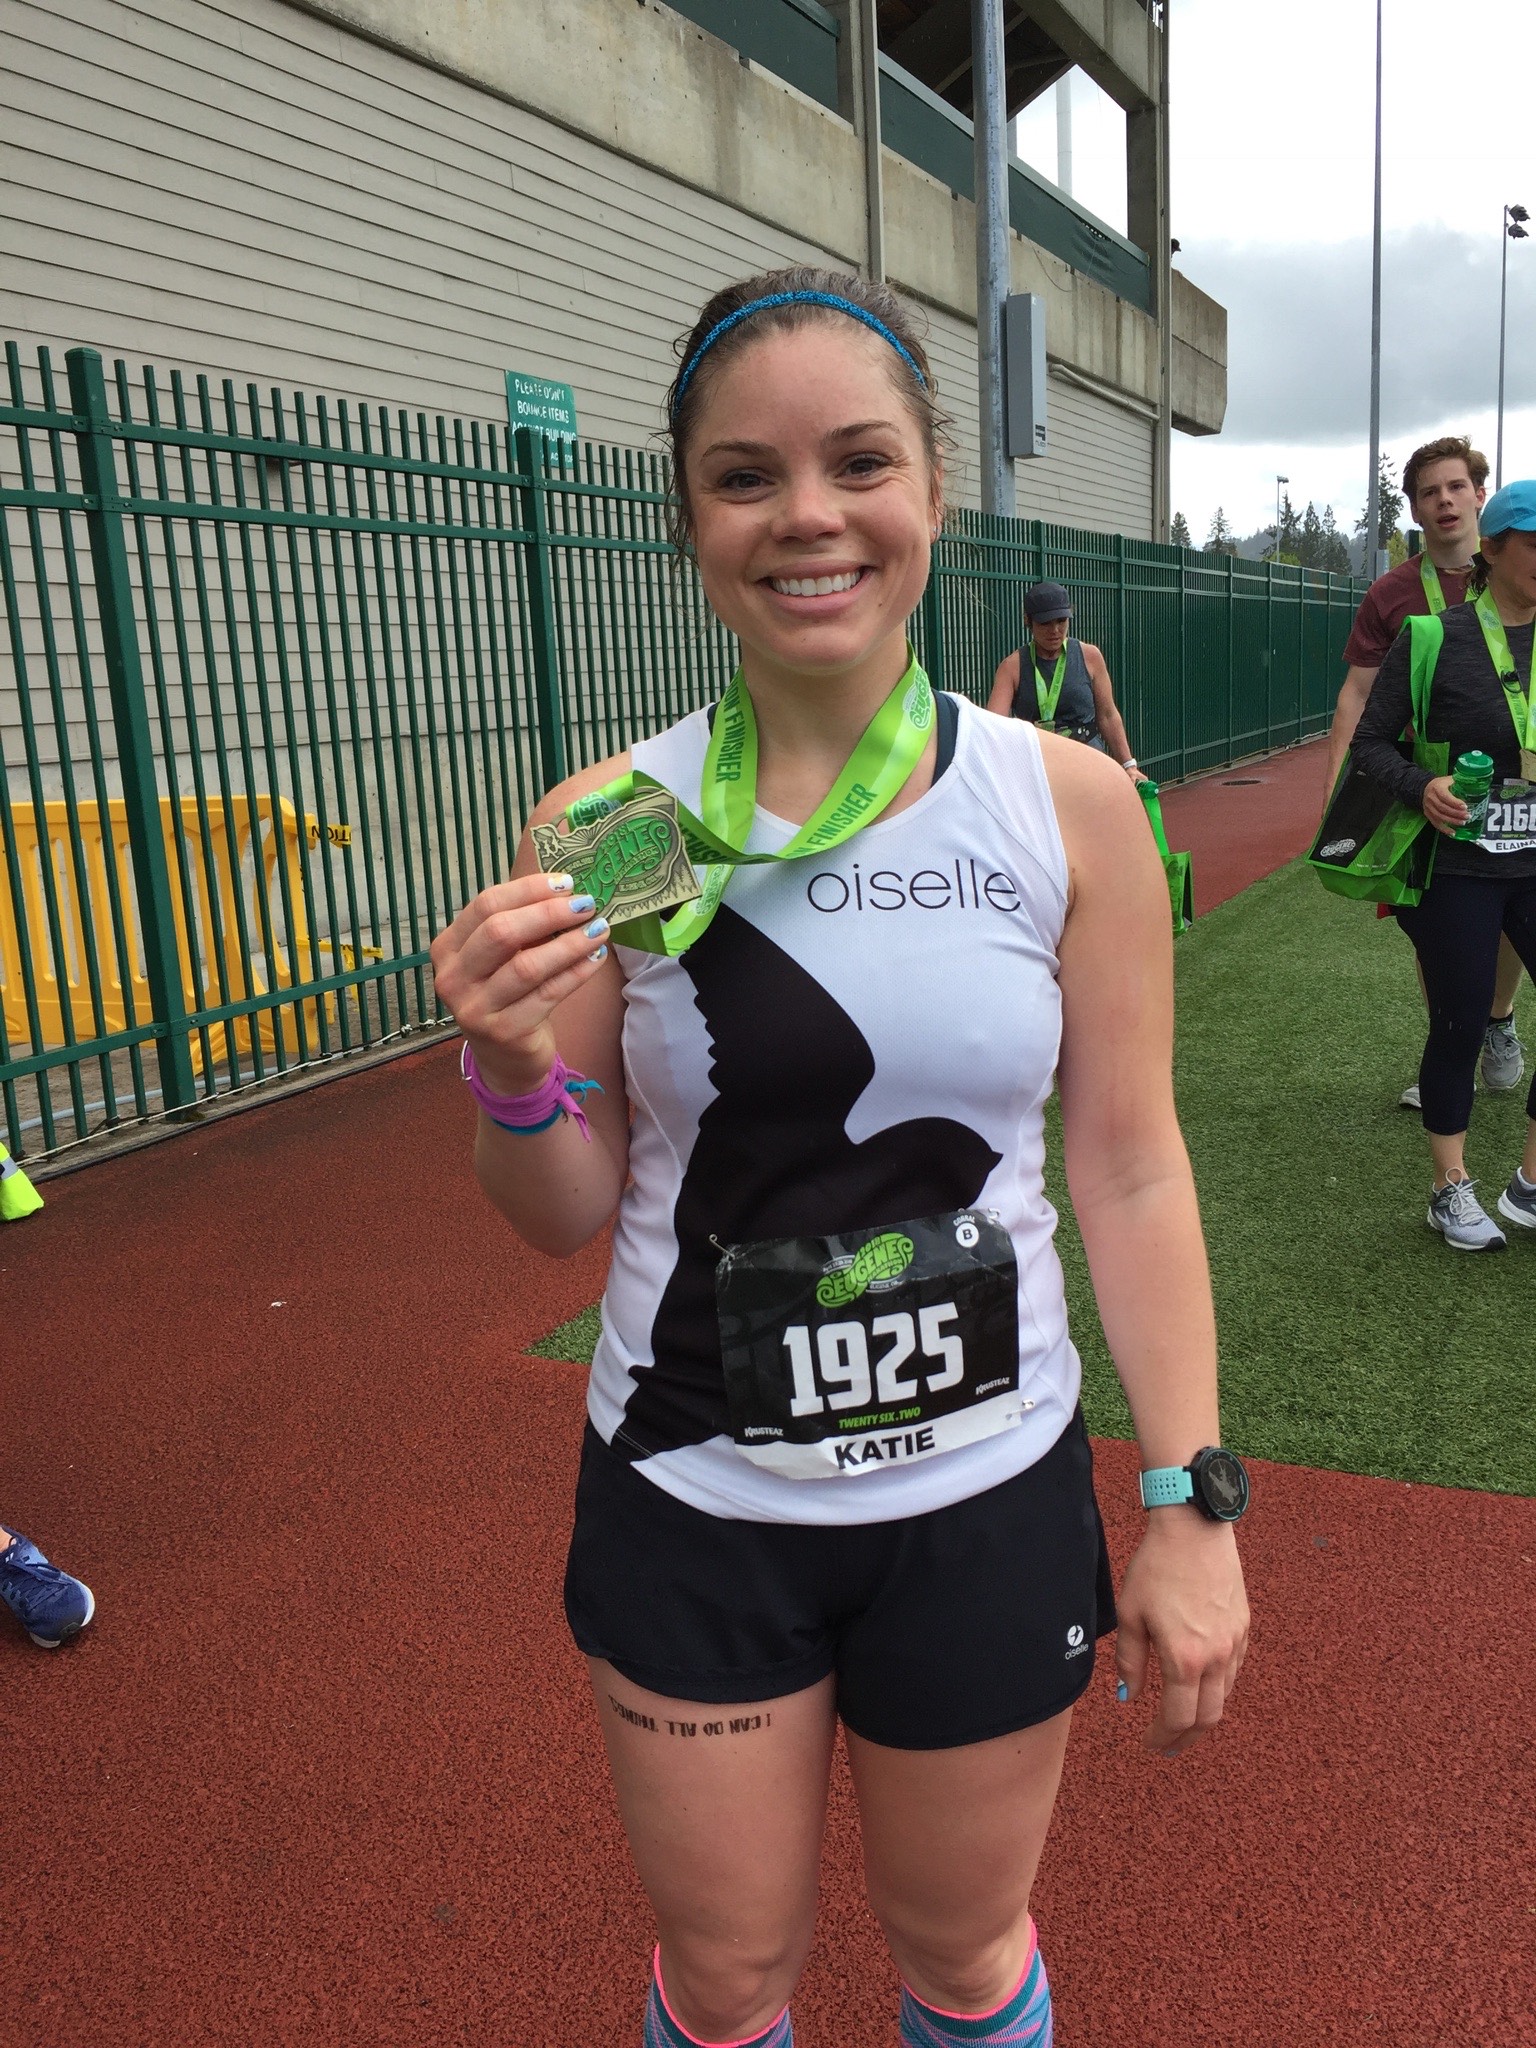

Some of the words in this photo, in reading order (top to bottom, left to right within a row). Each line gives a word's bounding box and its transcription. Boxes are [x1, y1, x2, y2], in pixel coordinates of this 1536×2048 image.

[514, 379, 543, 397] PLEASE
[548, 407, 569, 424] ITEMS
[716, 710, 746, 784] FINISHER
[807, 783, 878, 846] FINISHER
[807, 858, 1022, 913] oiselle
[962, 1229, 973, 1240] B
[782, 1302, 965, 1418] 1925
[838, 1413, 878, 1430] TWENTY
[834, 1426, 936, 1470] KATIE
[1064, 1643, 1089, 1660] oiselle
[663, 1719, 697, 1738] ALL
[702, 1721, 724, 1737] DO
[728, 1715, 761, 1735] CAN
